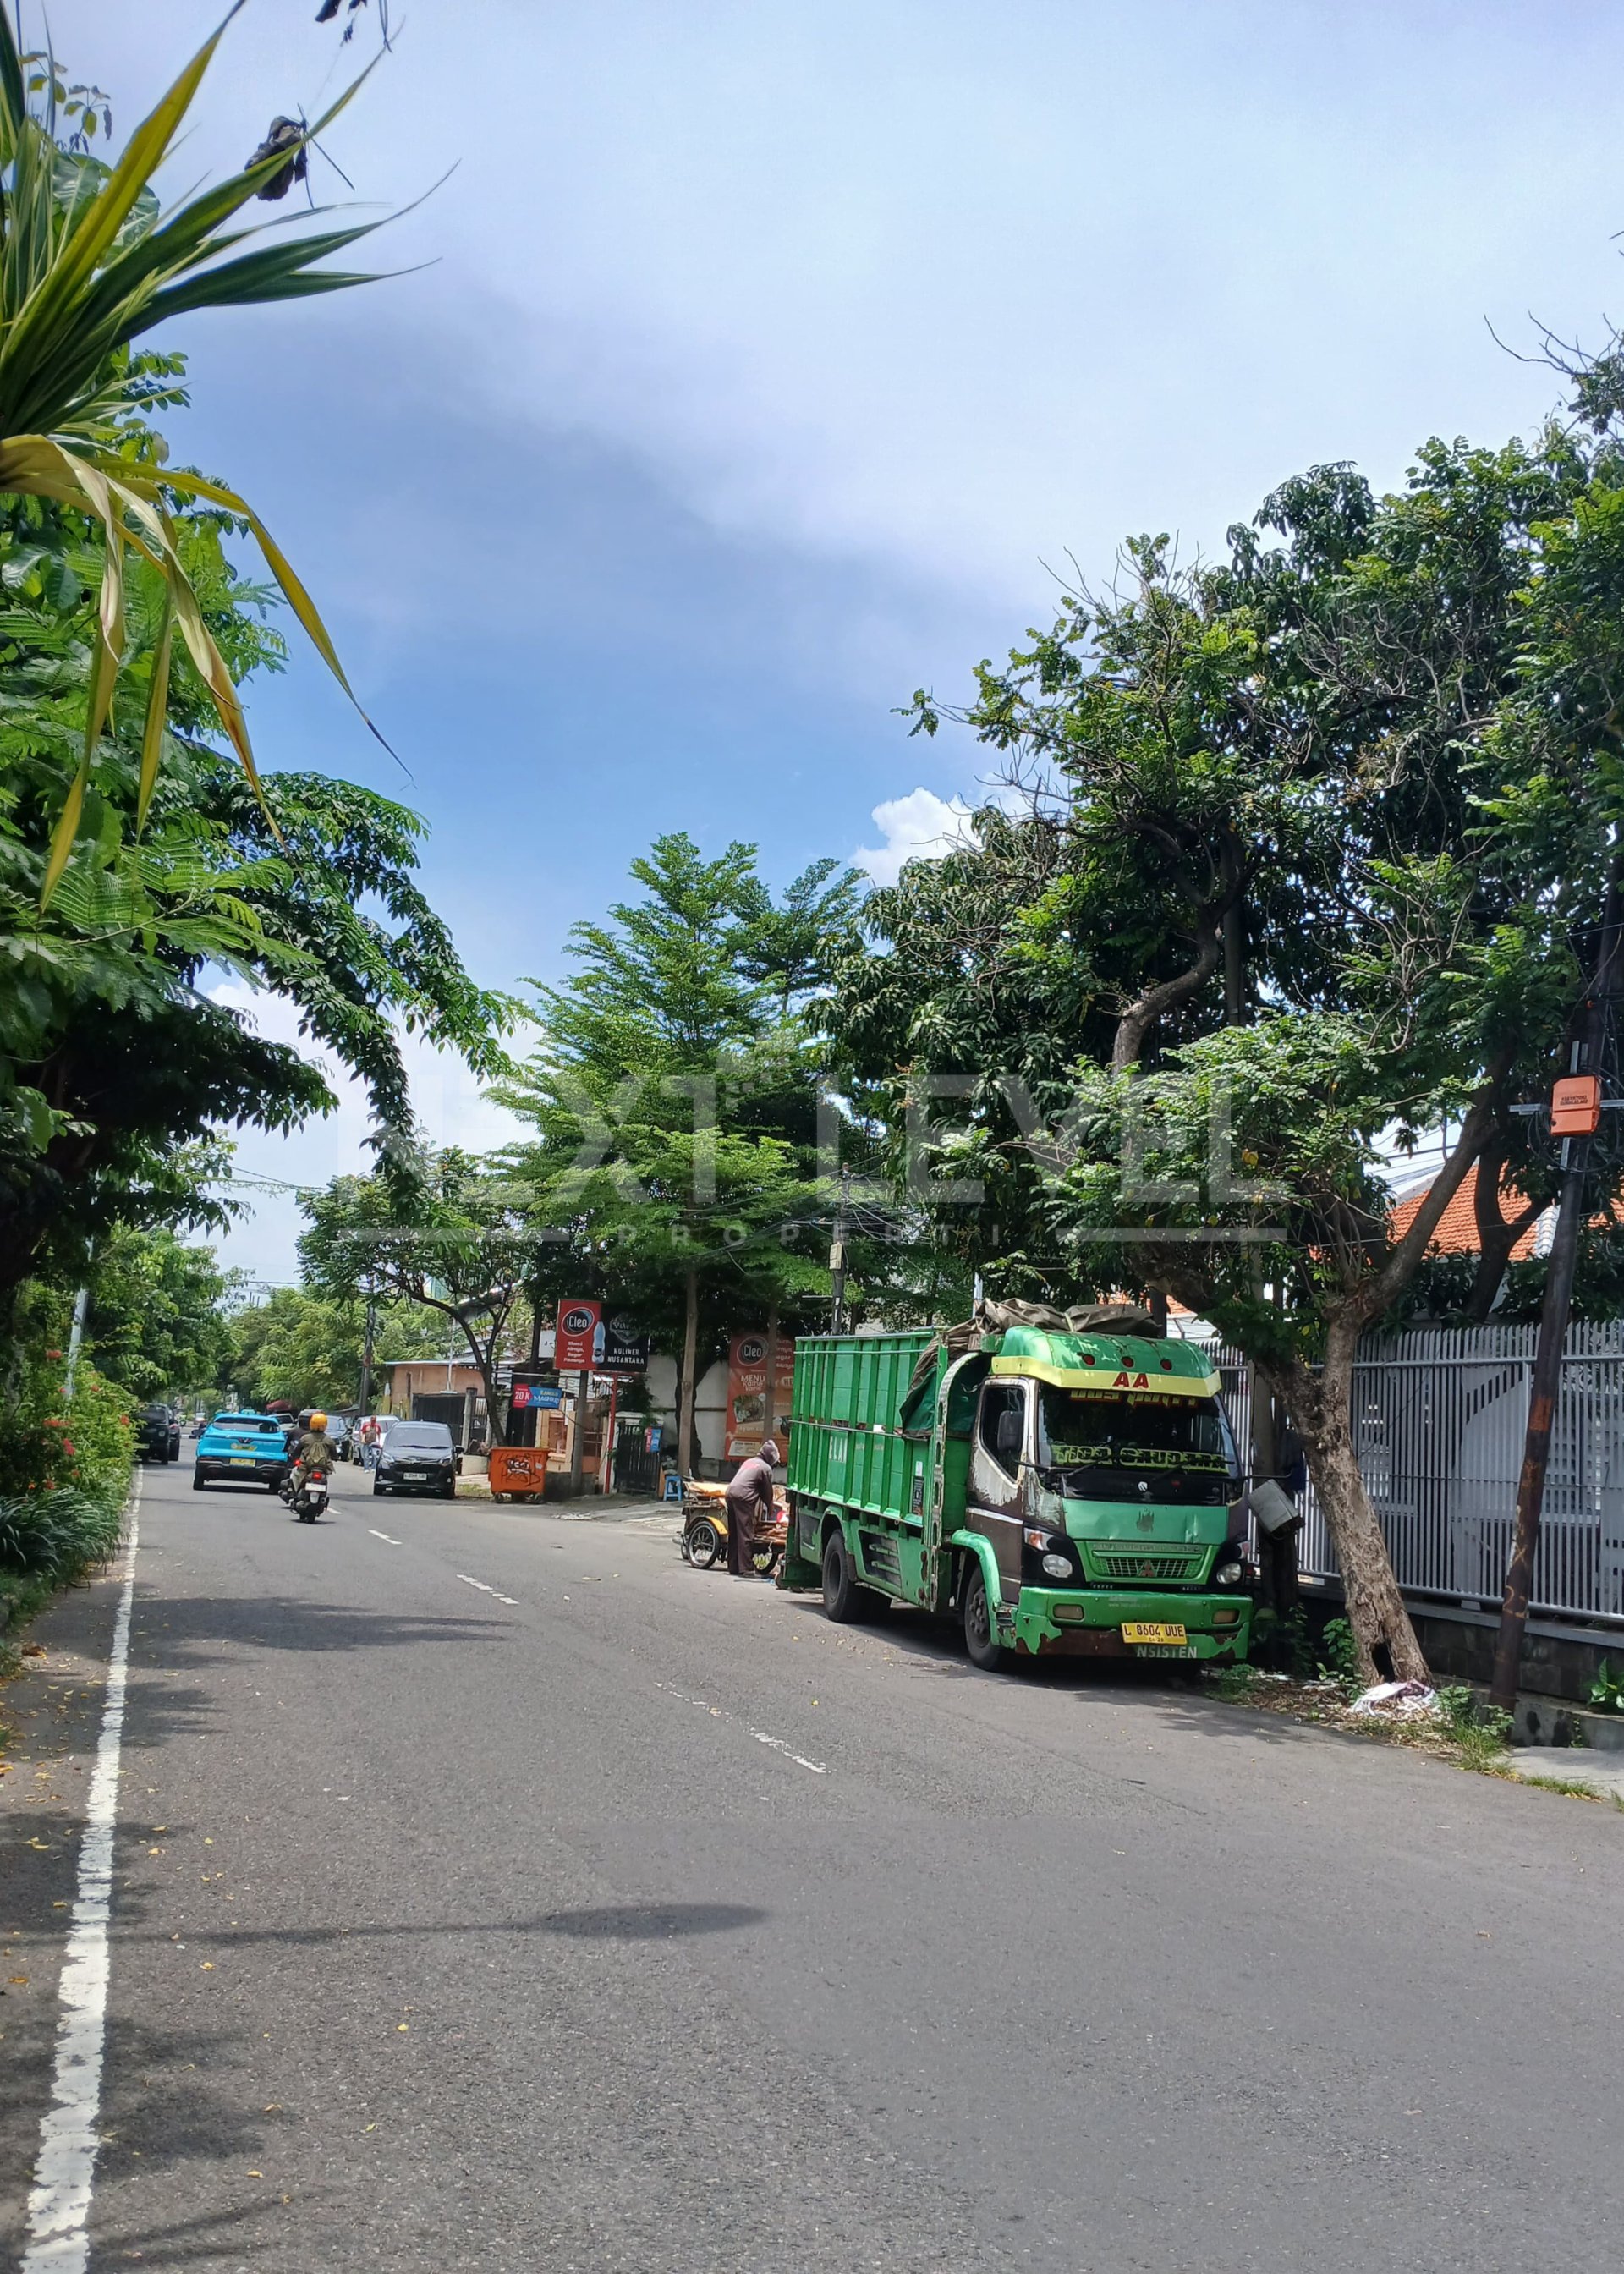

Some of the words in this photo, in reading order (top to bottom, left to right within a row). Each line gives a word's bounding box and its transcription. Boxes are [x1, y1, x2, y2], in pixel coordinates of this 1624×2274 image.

[568, 1316, 588, 1328] Cleo
[744, 1345, 762, 1357] Cleo
[607, 1356, 645, 1365] NUSANTARA
[515, 1391, 524, 1400] 20
[524, 1392, 530, 1400] K
[1124, 1625, 1132, 1636] L
[1136, 1624, 1161, 1636] 8604
[1165, 1624, 1184, 1637] UUE
[1136, 1645, 1198, 1659] NSISTEN
